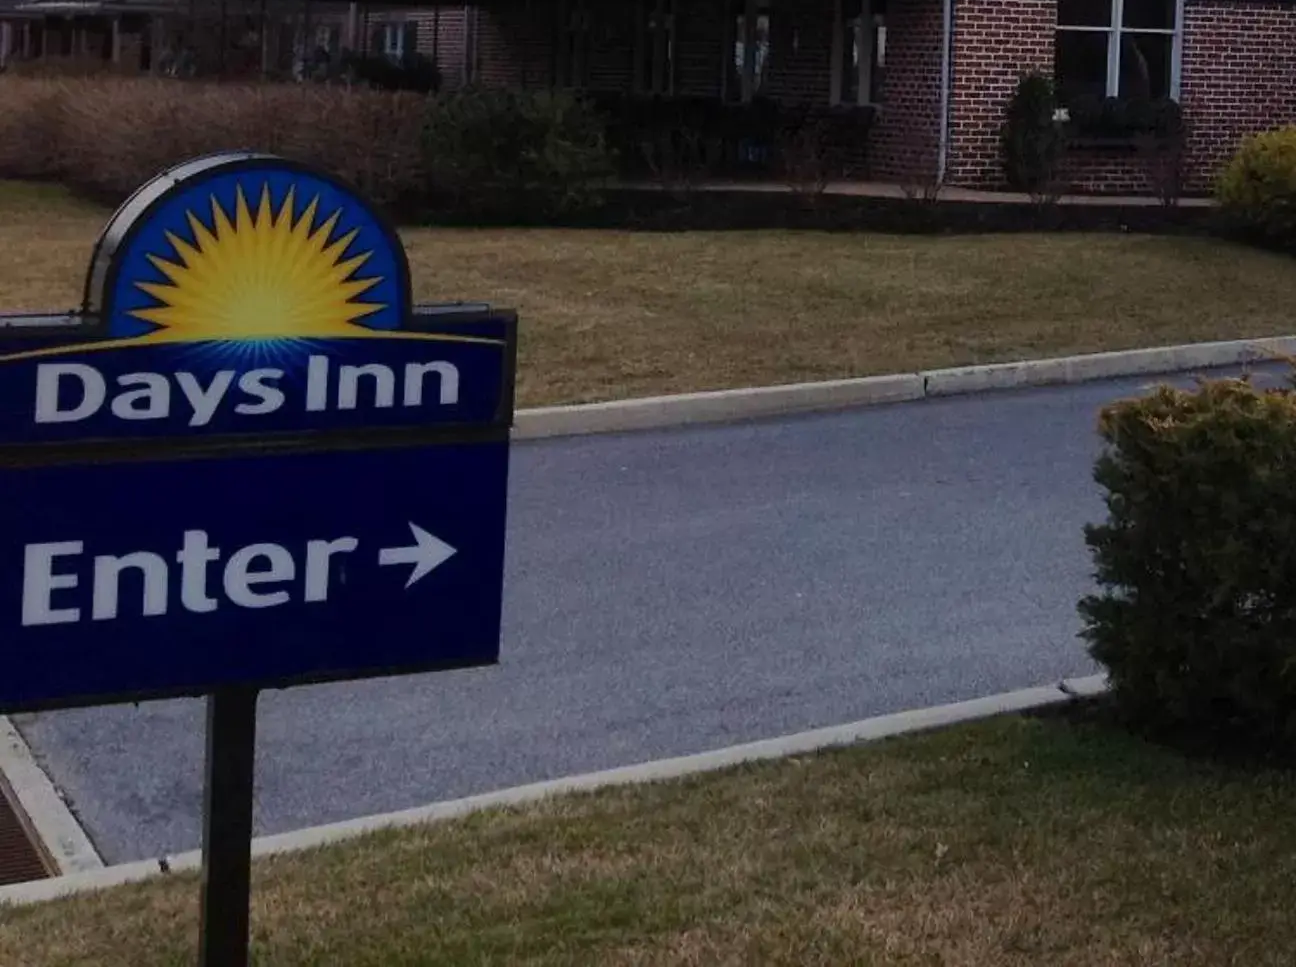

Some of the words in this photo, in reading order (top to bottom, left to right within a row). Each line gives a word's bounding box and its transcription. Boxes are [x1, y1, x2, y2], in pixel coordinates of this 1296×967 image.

[34, 362, 285, 427] Days
[306, 355, 459, 412] Inn
[21, 530, 359, 626] Enter
